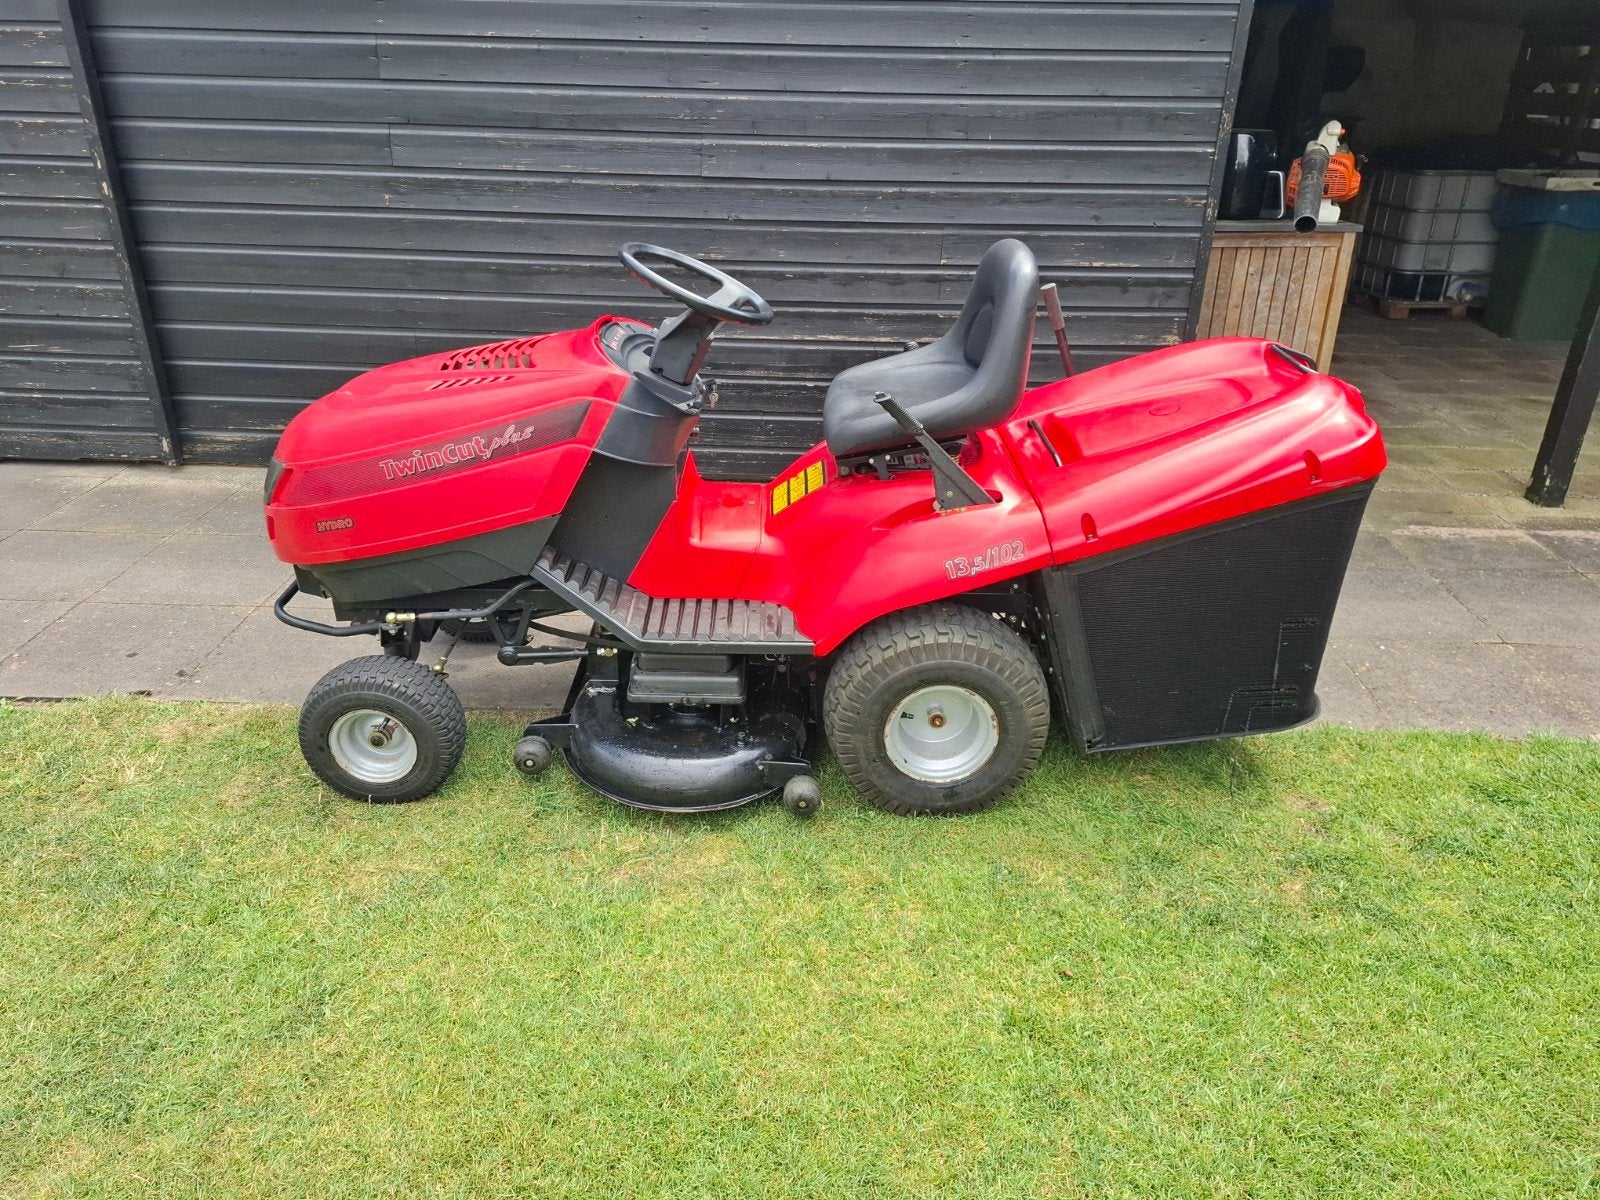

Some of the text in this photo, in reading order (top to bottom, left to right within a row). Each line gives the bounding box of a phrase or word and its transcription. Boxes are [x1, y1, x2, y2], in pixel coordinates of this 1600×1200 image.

[379, 424, 535, 481] TwinCut plus
[316, 517, 354, 532] HYDRO
[944, 539, 1025, 579] 13,5/102
